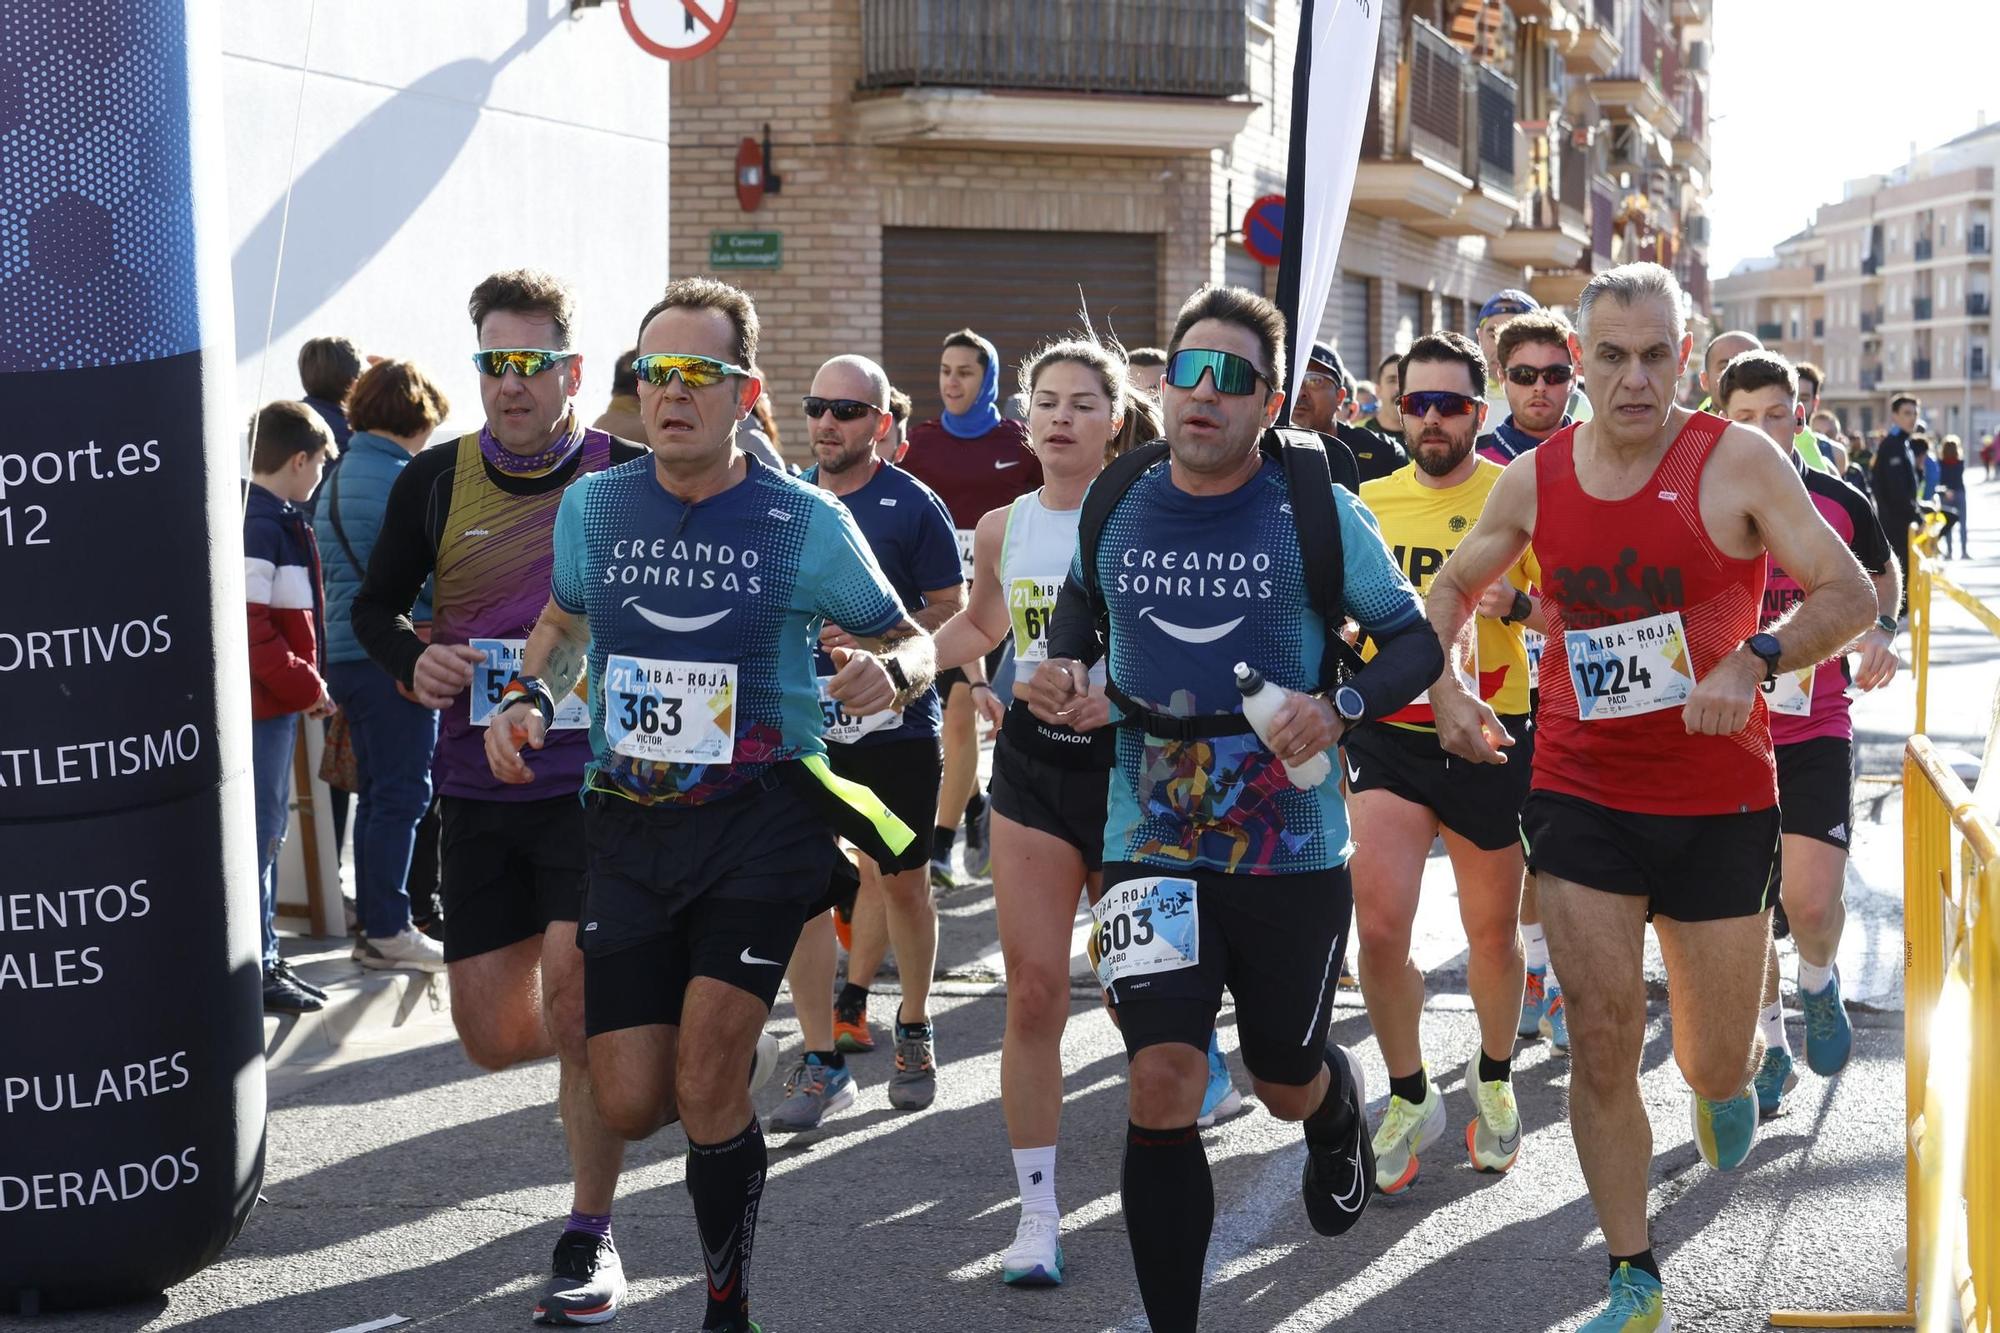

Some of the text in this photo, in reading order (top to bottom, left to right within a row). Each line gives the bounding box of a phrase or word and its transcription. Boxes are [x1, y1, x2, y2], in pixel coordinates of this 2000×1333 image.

[0, 439, 161, 499] port.es
[0, 505, 51, 546] 12
[613, 538, 759, 569] CREANDO
[1123, 548, 1270, 572] CREANDO
[603, 565, 762, 594] SONRISAS
[1117, 573, 1273, 599] SONRISAS
[0, 614, 172, 671] ORTIVOS
[611, 667, 631, 692] 21
[1575, 655, 1652, 698] 1224
[619, 691, 683, 737] 363
[1606, 694, 1627, 706] PACO
[635, 733, 663, 746] VICTOR
[1037, 724, 1092, 744] SALOMON
[1096, 906, 1155, 960] 603
[0, 946, 104, 990] ALES
[4, 1051, 191, 1113] PULARES
[0, 1146, 200, 1212] DERADOS
